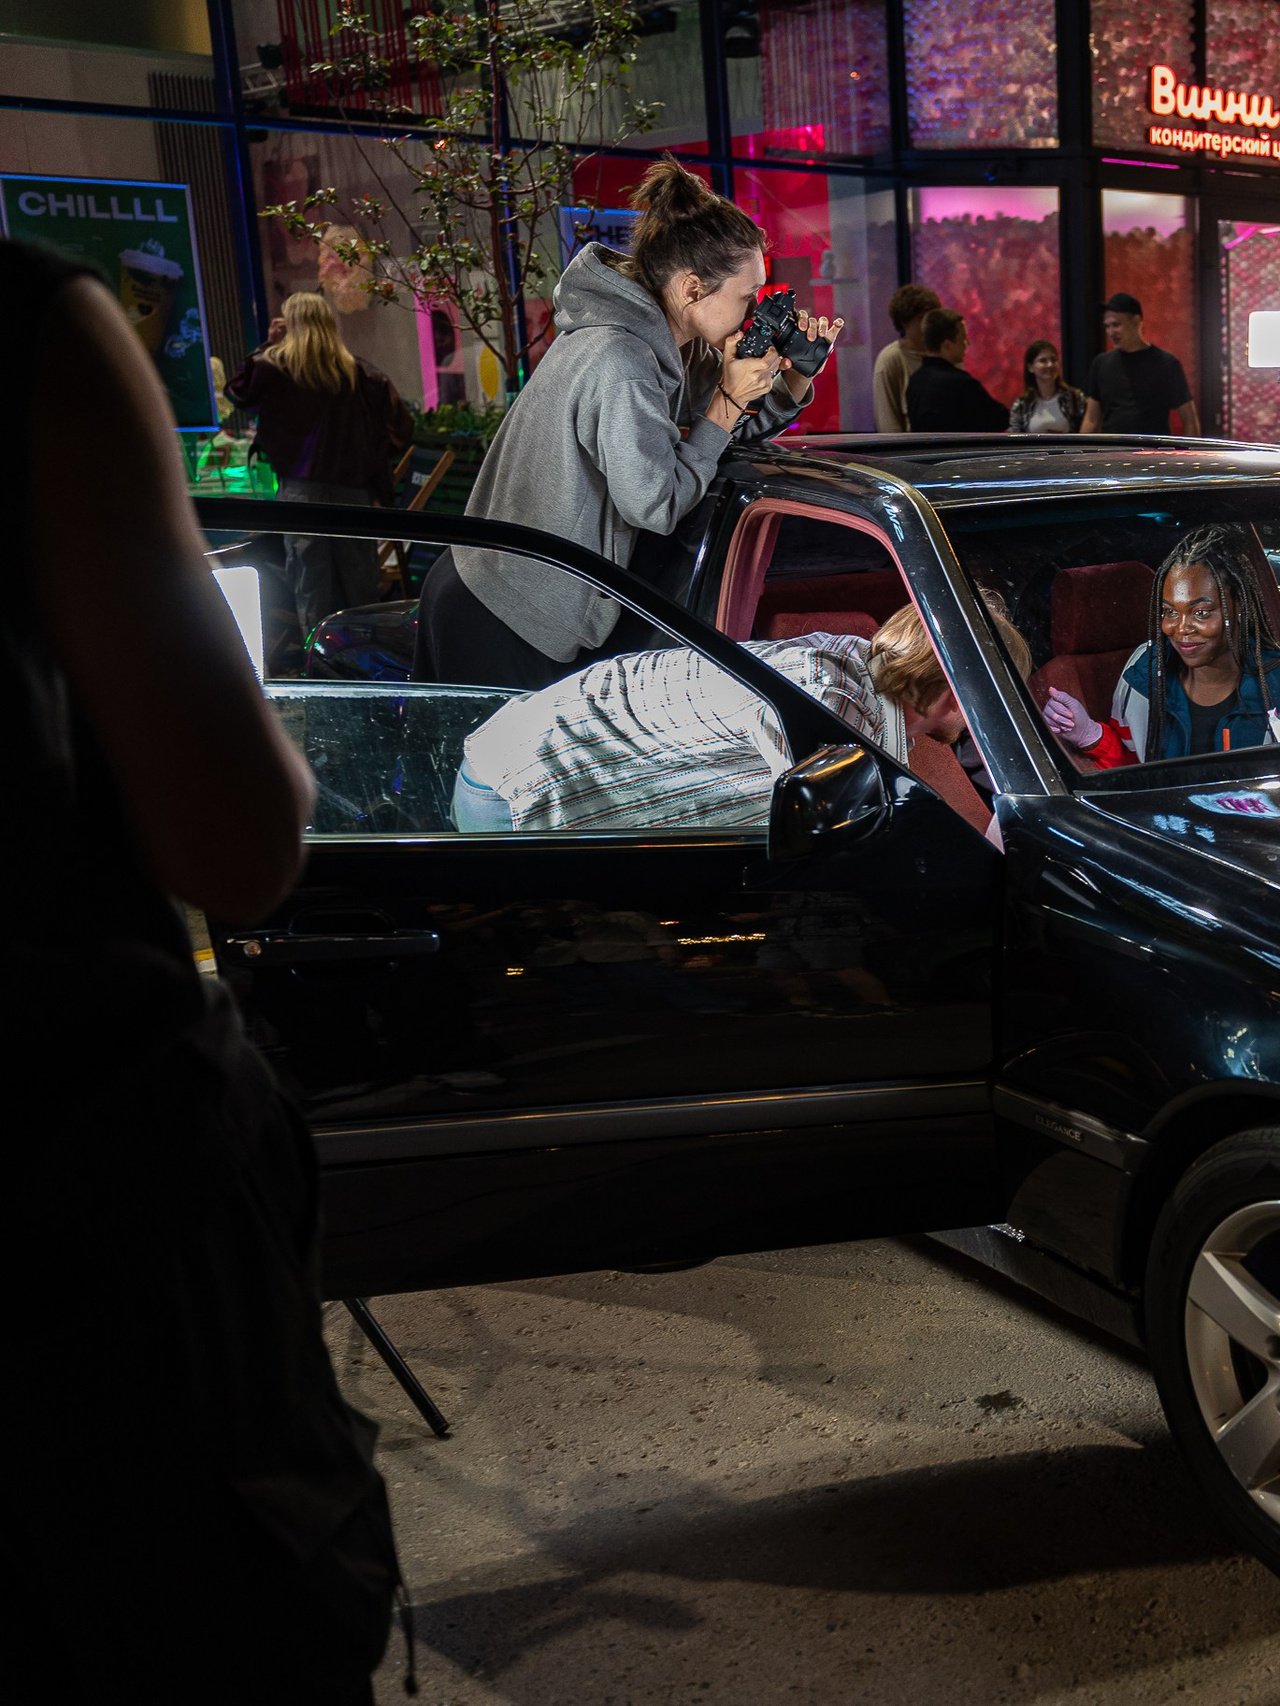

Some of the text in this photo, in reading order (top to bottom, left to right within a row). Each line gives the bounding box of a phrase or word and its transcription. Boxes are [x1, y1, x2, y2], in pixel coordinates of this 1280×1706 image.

[1150, 126, 1271, 158] кондитерский
[18, 191, 178, 223] CHILLLL
[1034, 1114, 1082, 1142] ELEGANCE
